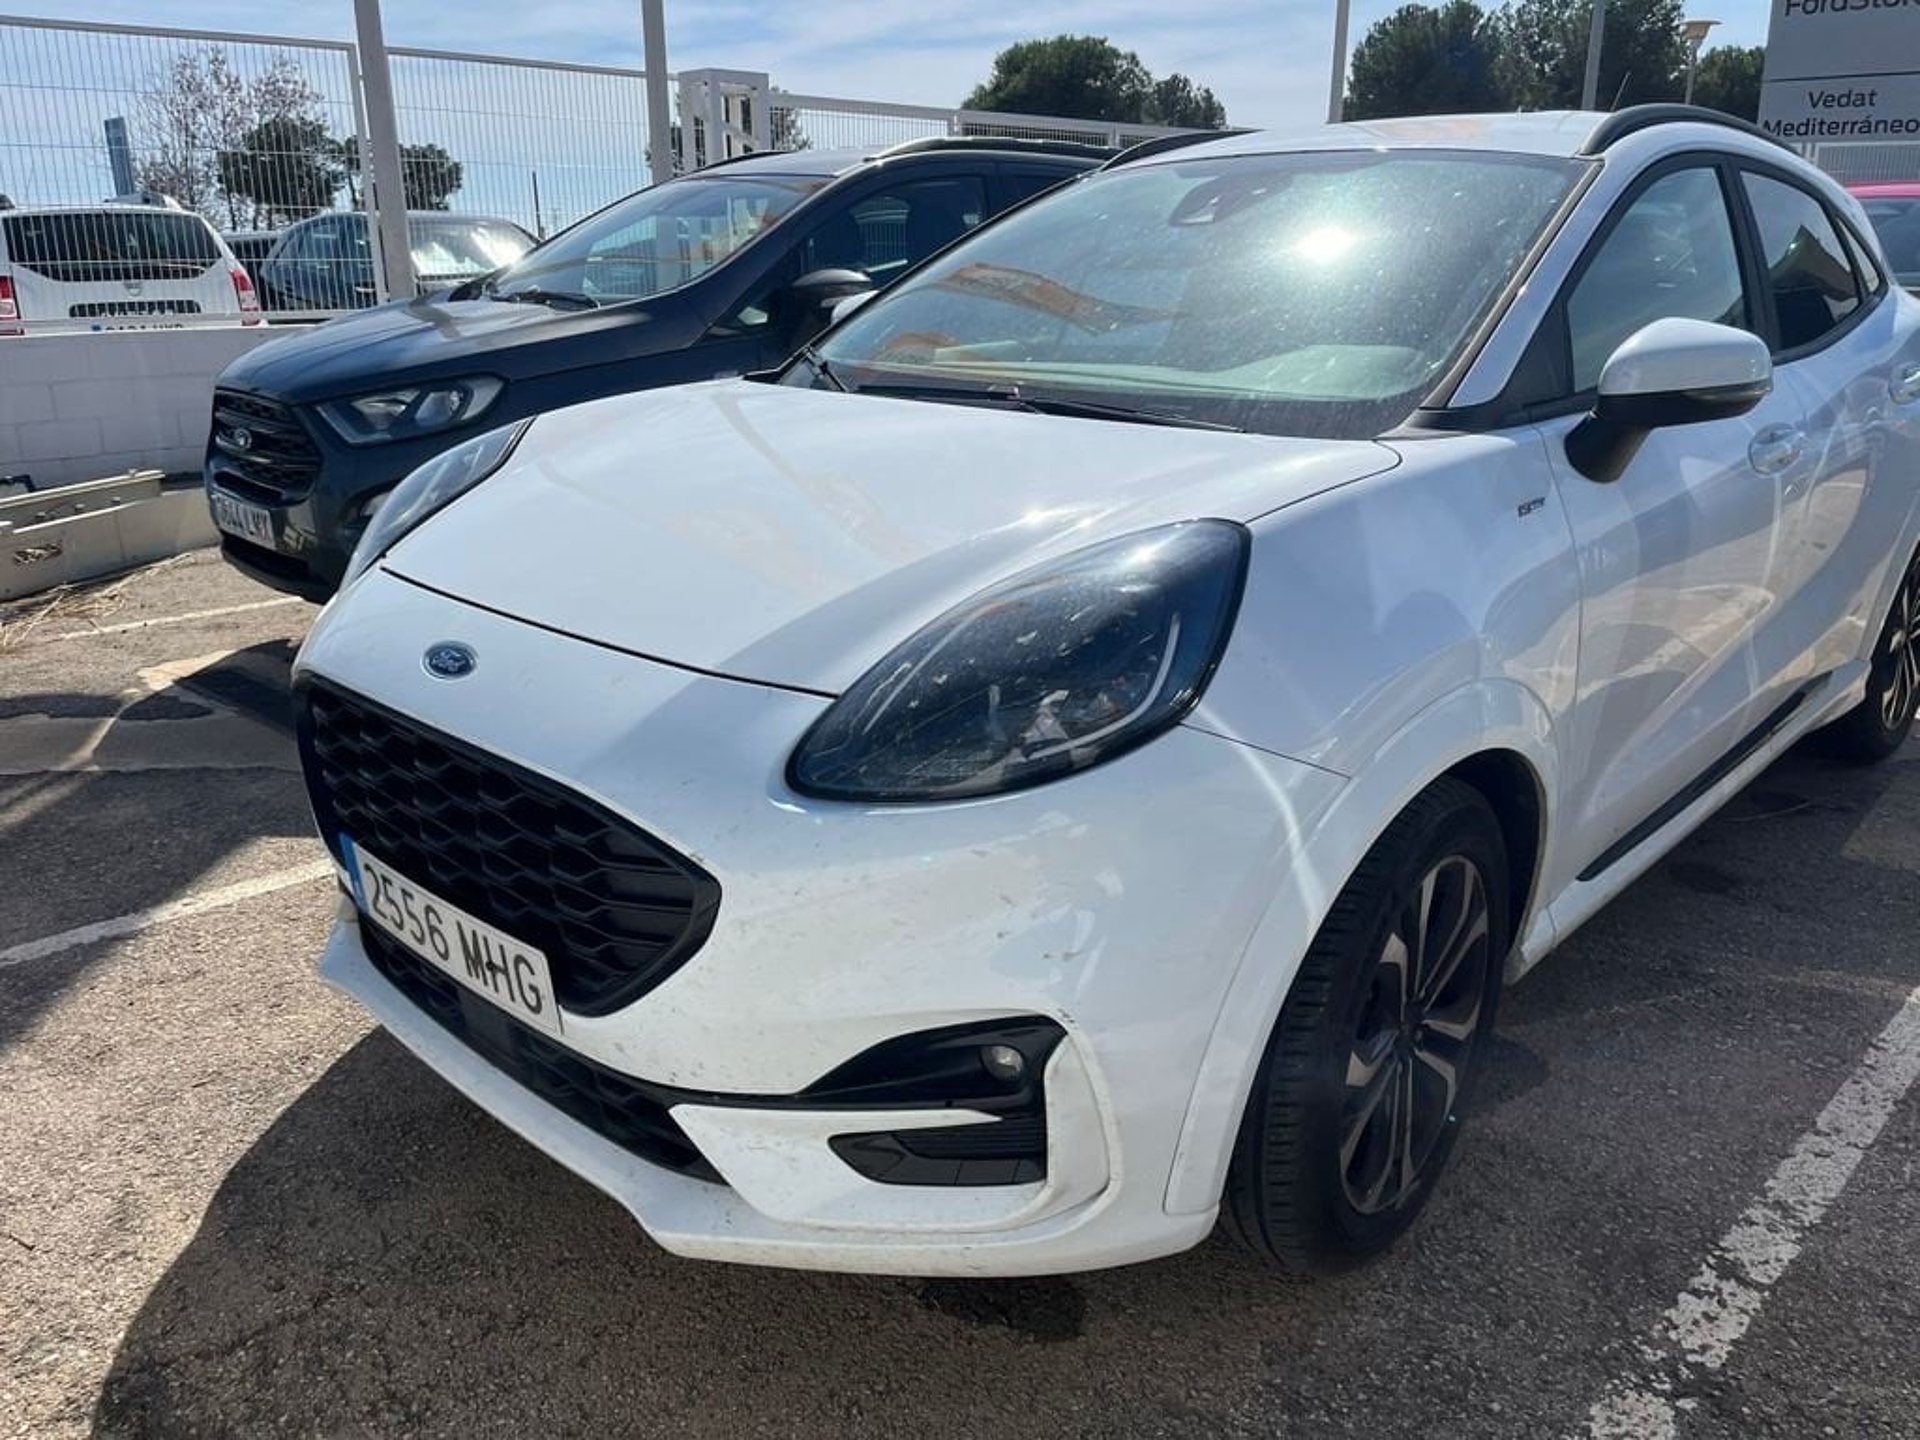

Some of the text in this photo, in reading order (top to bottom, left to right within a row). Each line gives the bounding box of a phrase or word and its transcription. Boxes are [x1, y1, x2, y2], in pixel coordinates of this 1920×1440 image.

[1807, 89, 1878, 109] Vedat
[1762, 114, 1920, 137] Mediterráneo
[363, 862, 542, 1015] 2556 MHG
